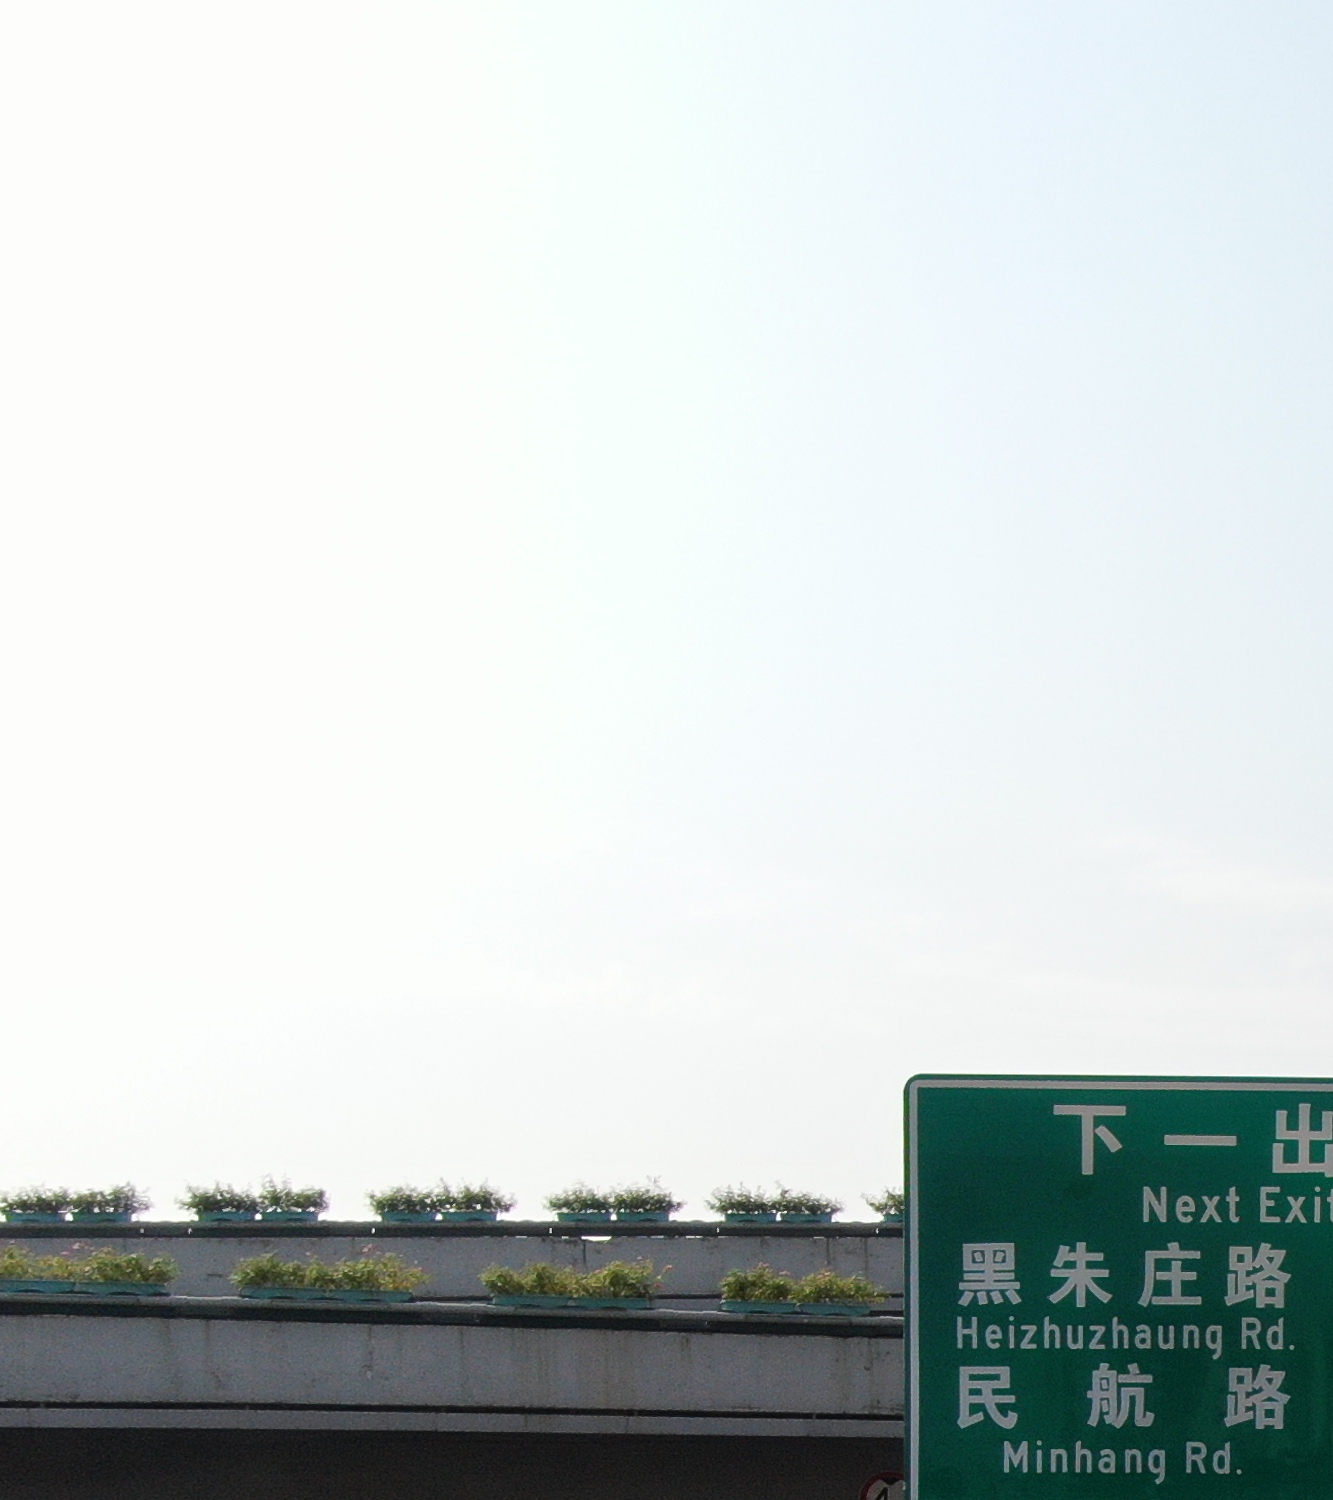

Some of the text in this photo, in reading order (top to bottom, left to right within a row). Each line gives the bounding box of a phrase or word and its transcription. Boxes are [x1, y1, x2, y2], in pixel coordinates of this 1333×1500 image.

[1142, 1186, 1241, 1224] Next
[957, 1241, 1292, 1309] 黑朱庄路
[956, 1316, 1296, 1360] Heizhuzhaung Rd.
[957, 1362, 1292, 1430] 民航路
[1002, 1440, 1243, 1485] Minhang Rd.
